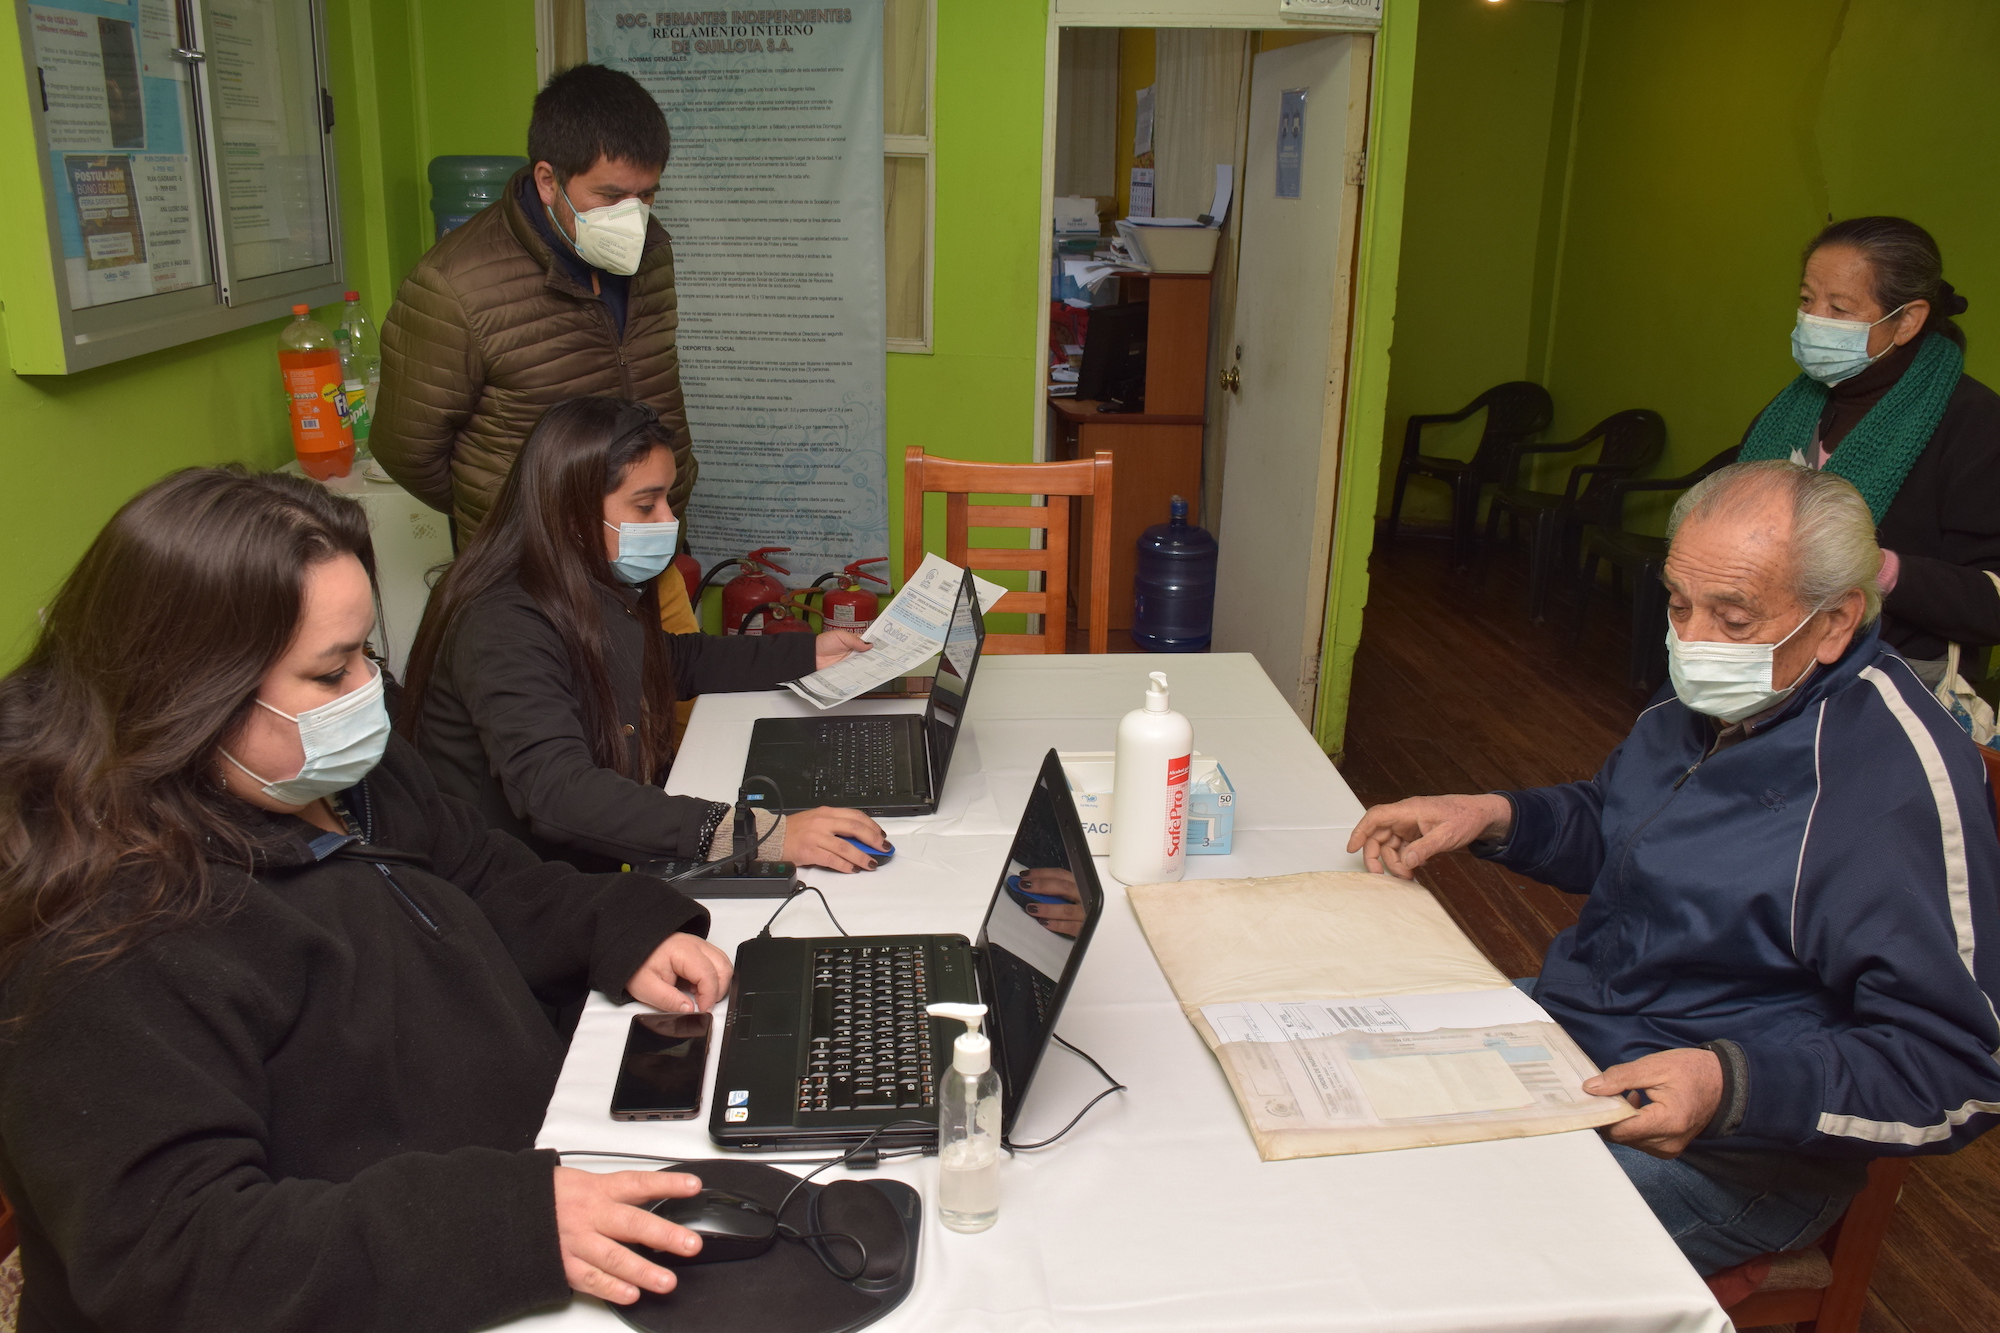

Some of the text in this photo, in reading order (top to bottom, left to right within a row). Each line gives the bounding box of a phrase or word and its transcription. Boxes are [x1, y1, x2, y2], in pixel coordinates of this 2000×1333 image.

[616, 8, 851, 27] SOC. FERIANTES INDEPENDIENTES
[653, 24, 813, 39] REGLAMENTO INTERNO
[672, 38, 793, 54] DE QUILLOTA S.A.
[75, 168, 125, 182] POSTULACIÓN
[77, 184, 97, 195] BONO
[98, 183, 107, 194] DE
[883, 622, 909, 643] Quillota
[1220, 795, 1232, 803] 50
[1167, 790, 1183, 858] SafePro
[1202, 837, 1210, 847] 3
